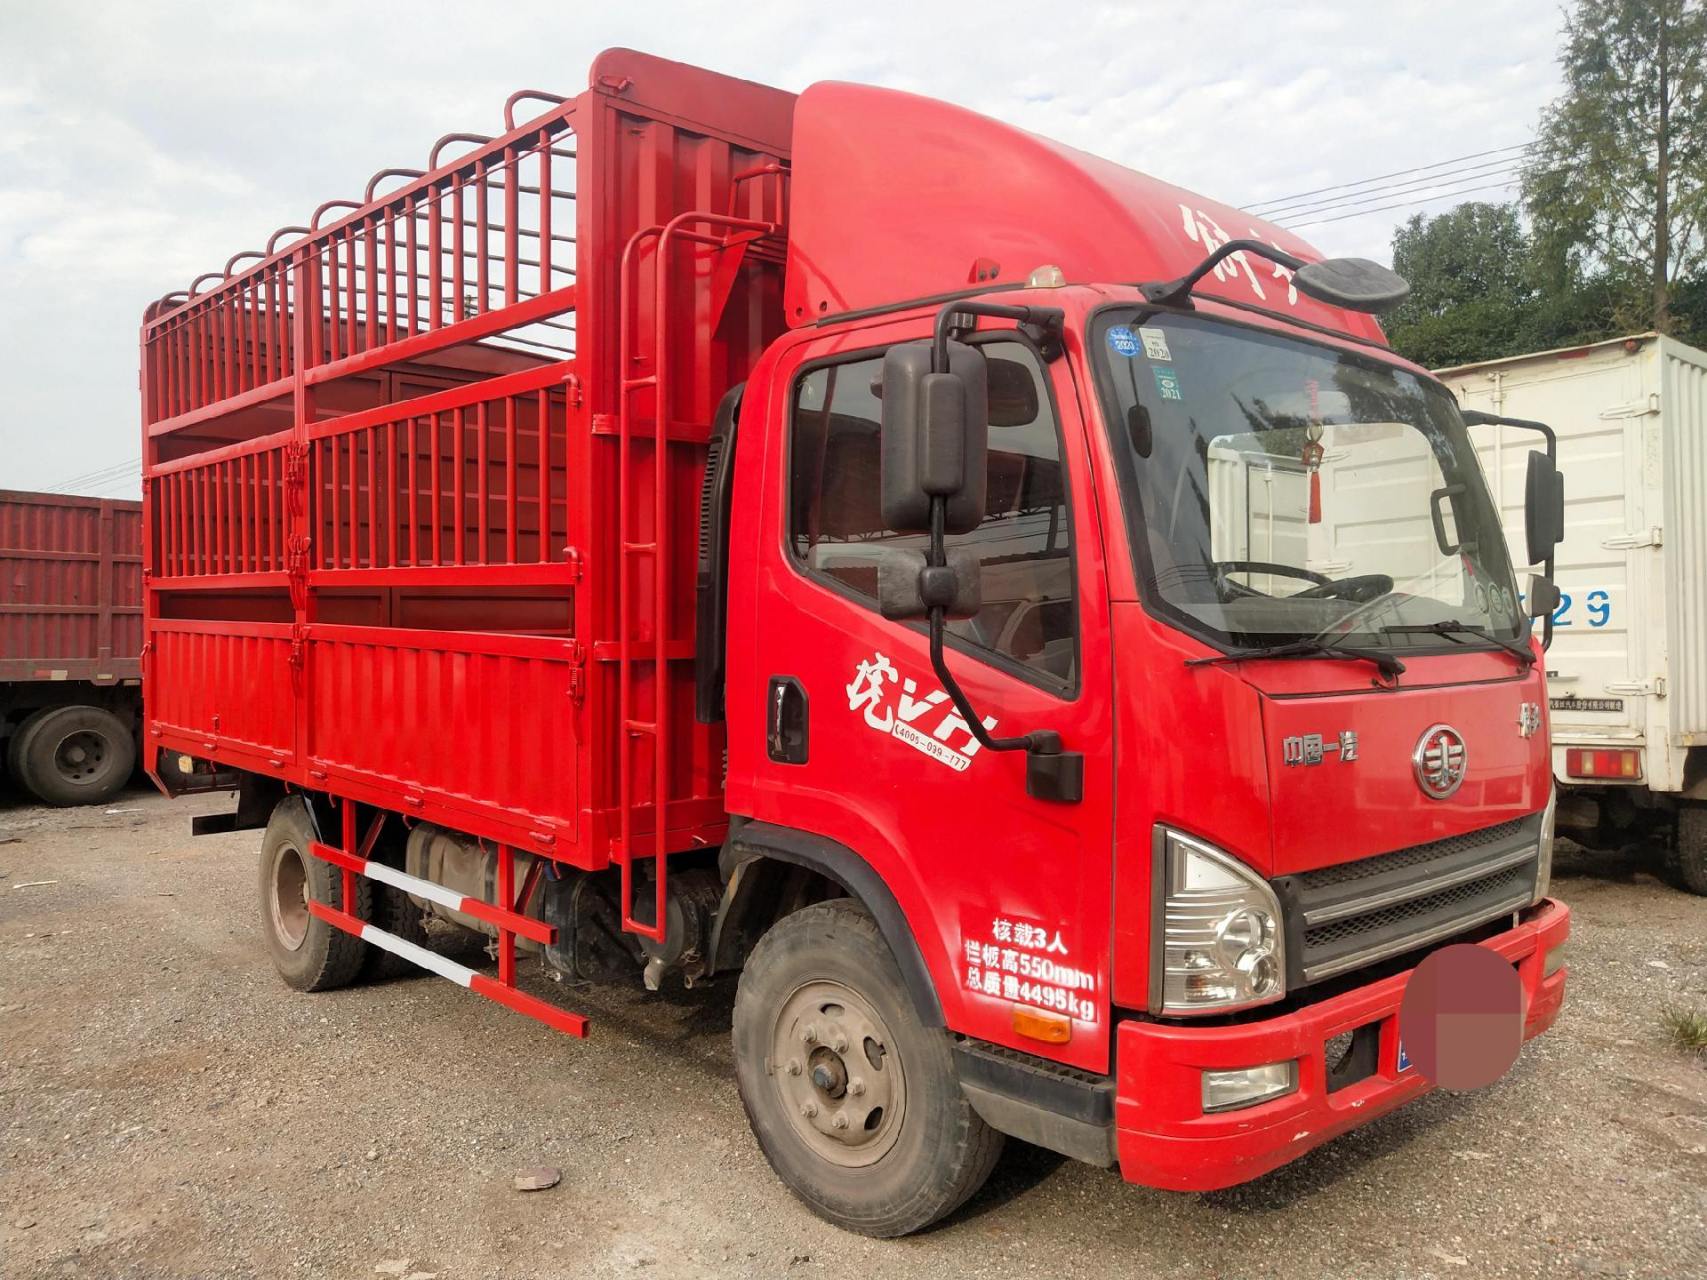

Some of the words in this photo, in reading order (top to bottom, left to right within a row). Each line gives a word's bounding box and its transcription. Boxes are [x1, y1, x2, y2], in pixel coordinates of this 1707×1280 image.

[1283, 730, 1359, 768] 中国一汽
[992, 917, 1069, 955] 核载3人
[965, 939, 1095, 992] 栏板高550mm
[966, 966, 1095, 1021] 总质量4495kg
